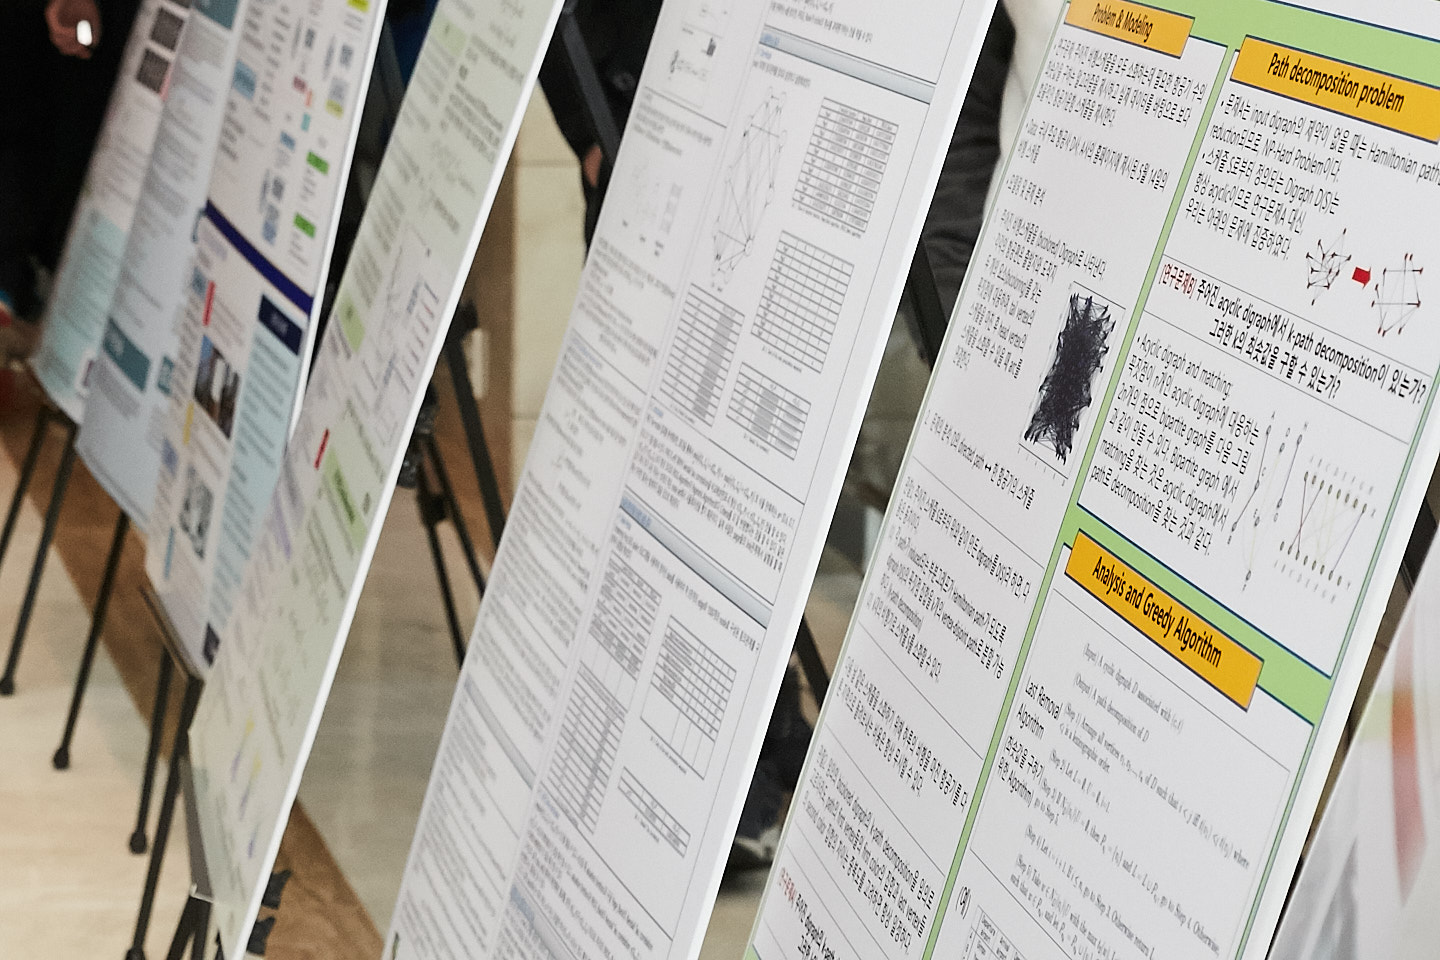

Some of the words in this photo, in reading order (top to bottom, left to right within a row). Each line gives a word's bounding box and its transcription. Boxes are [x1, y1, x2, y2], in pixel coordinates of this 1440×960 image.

[1091, 2, 1117, 27] Problem
[1121, 11, 1154, 43] Modeling
[1266, 52, 1290, 78] Path
[1288, 58, 1359, 99] decomposition
[1355, 82, 1405, 112] problem
[1261, 138, 1295, 165] NP-Hard
[1367, 142, 1418, 174] Hamiltonian
[1283, 176, 1314, 203] Digraph
[1217, 296, 1243, 318] acyclic
[1286, 322, 1314, 352] k-path
[1160, 345, 1187, 373] digraph
[1184, 360, 1202, 379] and
[1170, 385, 1194, 409] acyclic
[1158, 406, 1187, 438] bipartite
[1169, 445, 1199, 478] Bipartite
[1195, 467, 1220, 492] graph
[1161, 478, 1186, 504] acyclic
[1091, 555, 1126, 597] Analysis
[1124, 584, 1146, 610] and
[1142, 592, 1176, 638] Greedy
[1172, 615, 1222, 668] Algorithm
[1024, 678, 1039, 700] Last
[1036, 685, 1063, 719] Removal
[1016, 702, 1045, 737] Algorithm
